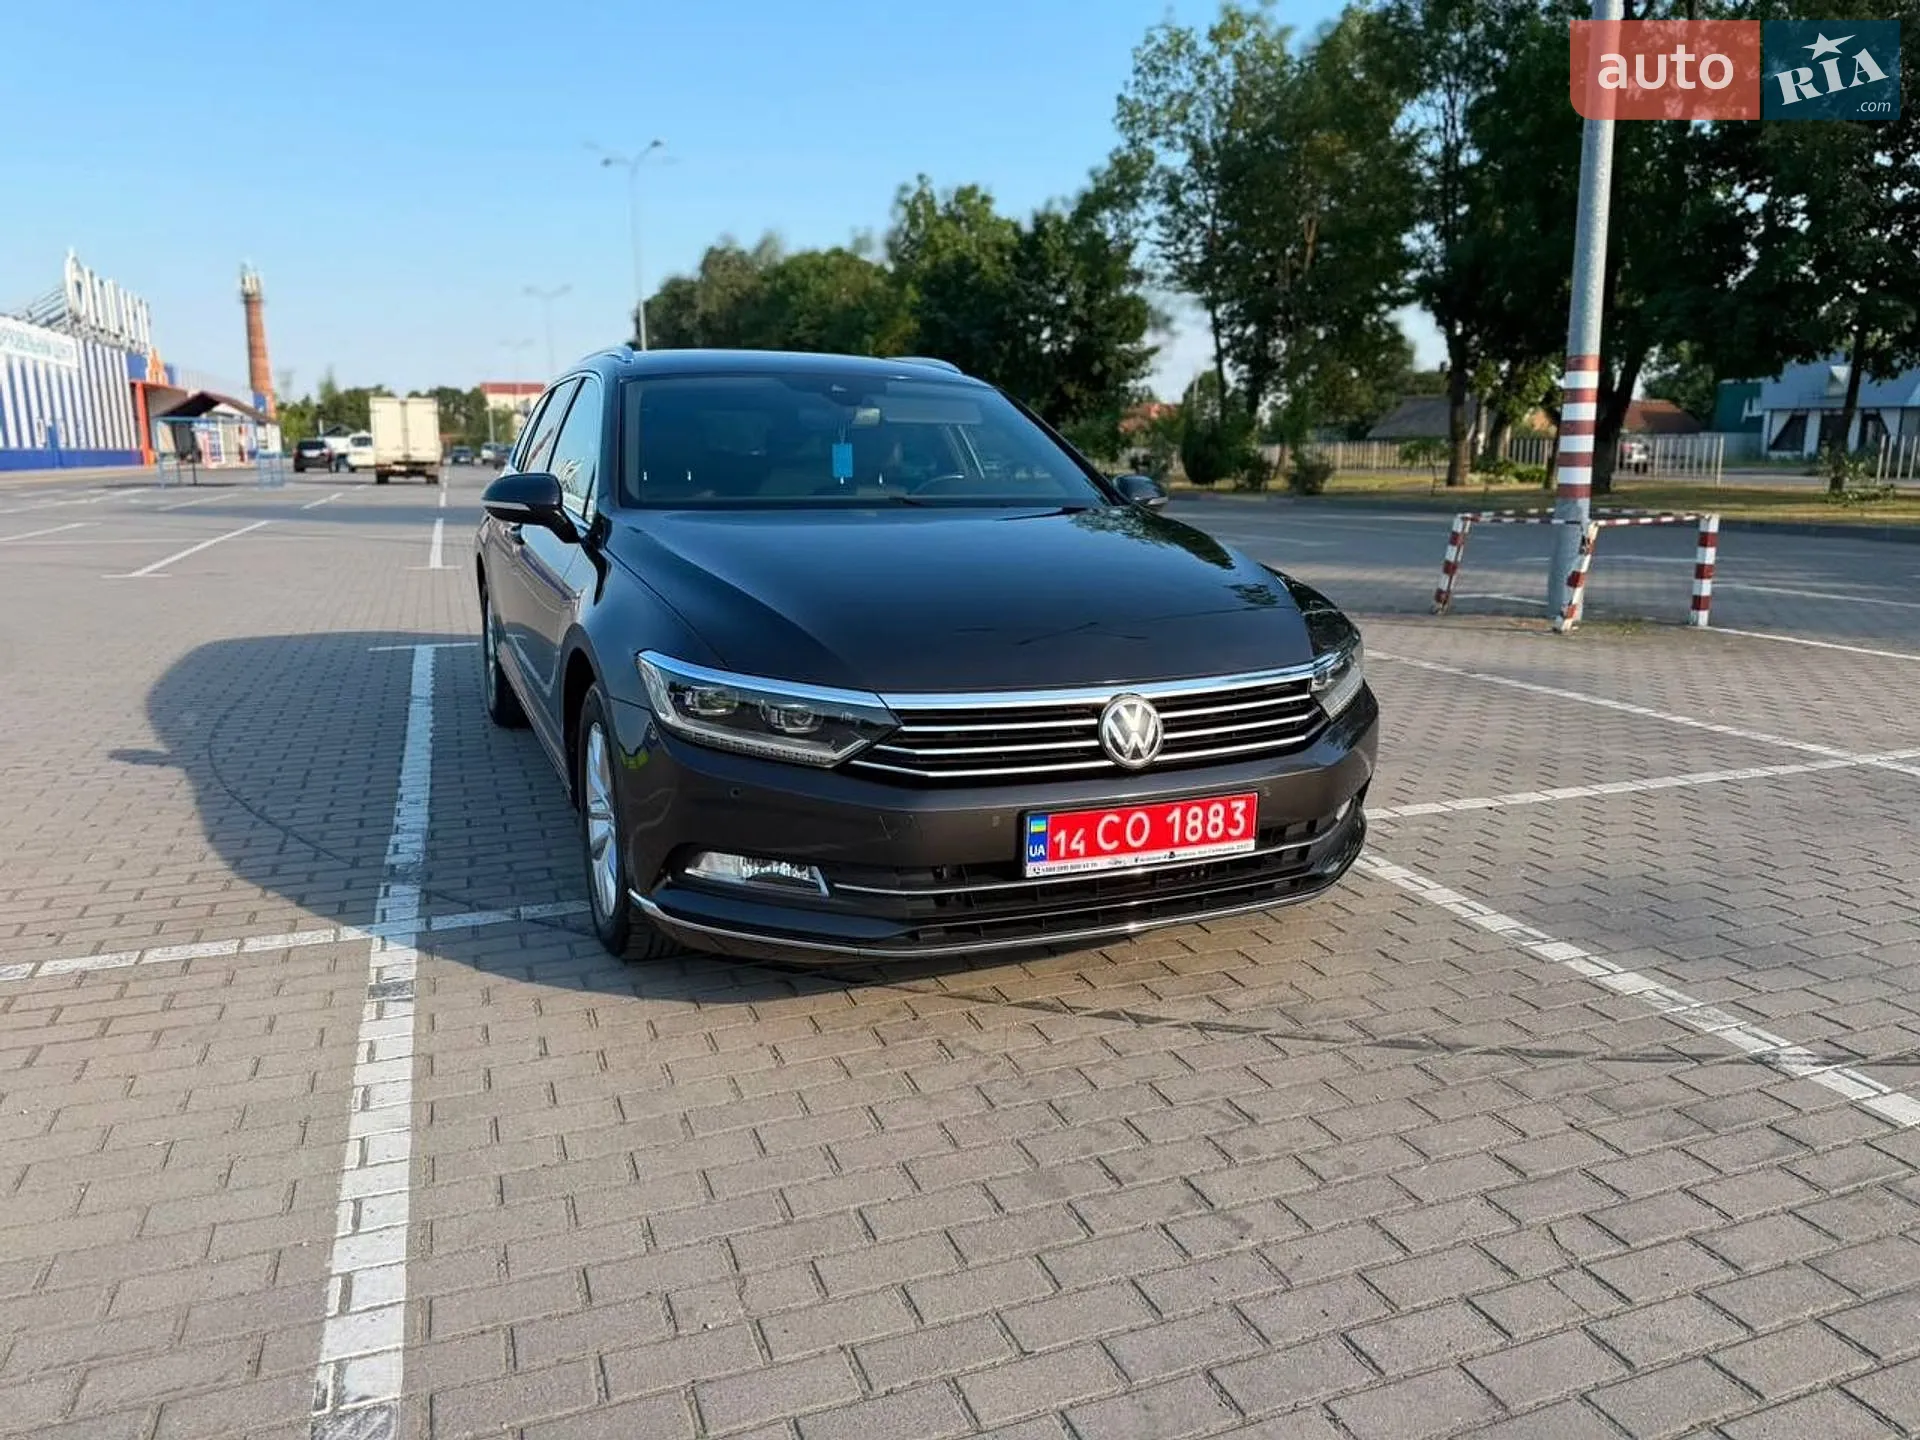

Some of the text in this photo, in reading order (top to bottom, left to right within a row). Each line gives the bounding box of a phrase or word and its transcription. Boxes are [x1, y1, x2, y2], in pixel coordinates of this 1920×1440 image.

[1053, 828, 1086, 858] 14
[1096, 811, 1151, 850] CO
[1166, 799, 1247, 844] 1883
[1028, 844, 1046, 858] UA
